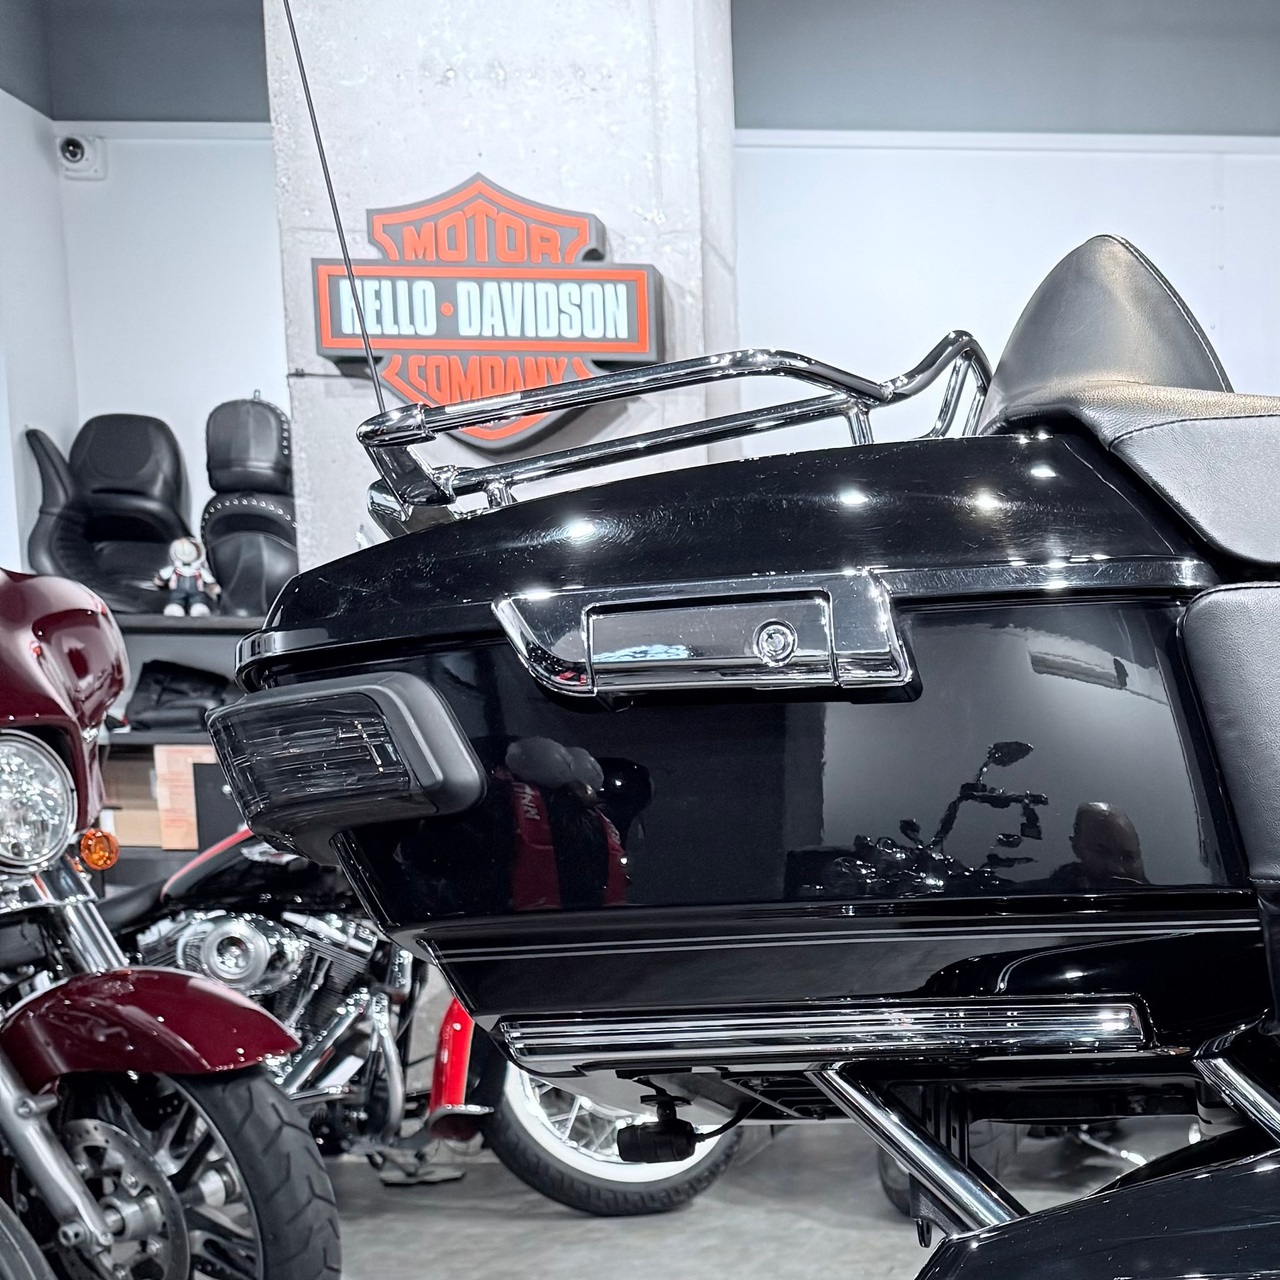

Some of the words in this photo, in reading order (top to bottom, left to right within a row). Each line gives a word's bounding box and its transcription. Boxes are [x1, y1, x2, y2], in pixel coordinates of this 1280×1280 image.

[403, 200, 561, 263] MOTOR
[339, 279, 437, 336] HELLO
[456, 281, 629, 338] DAVIDSON
